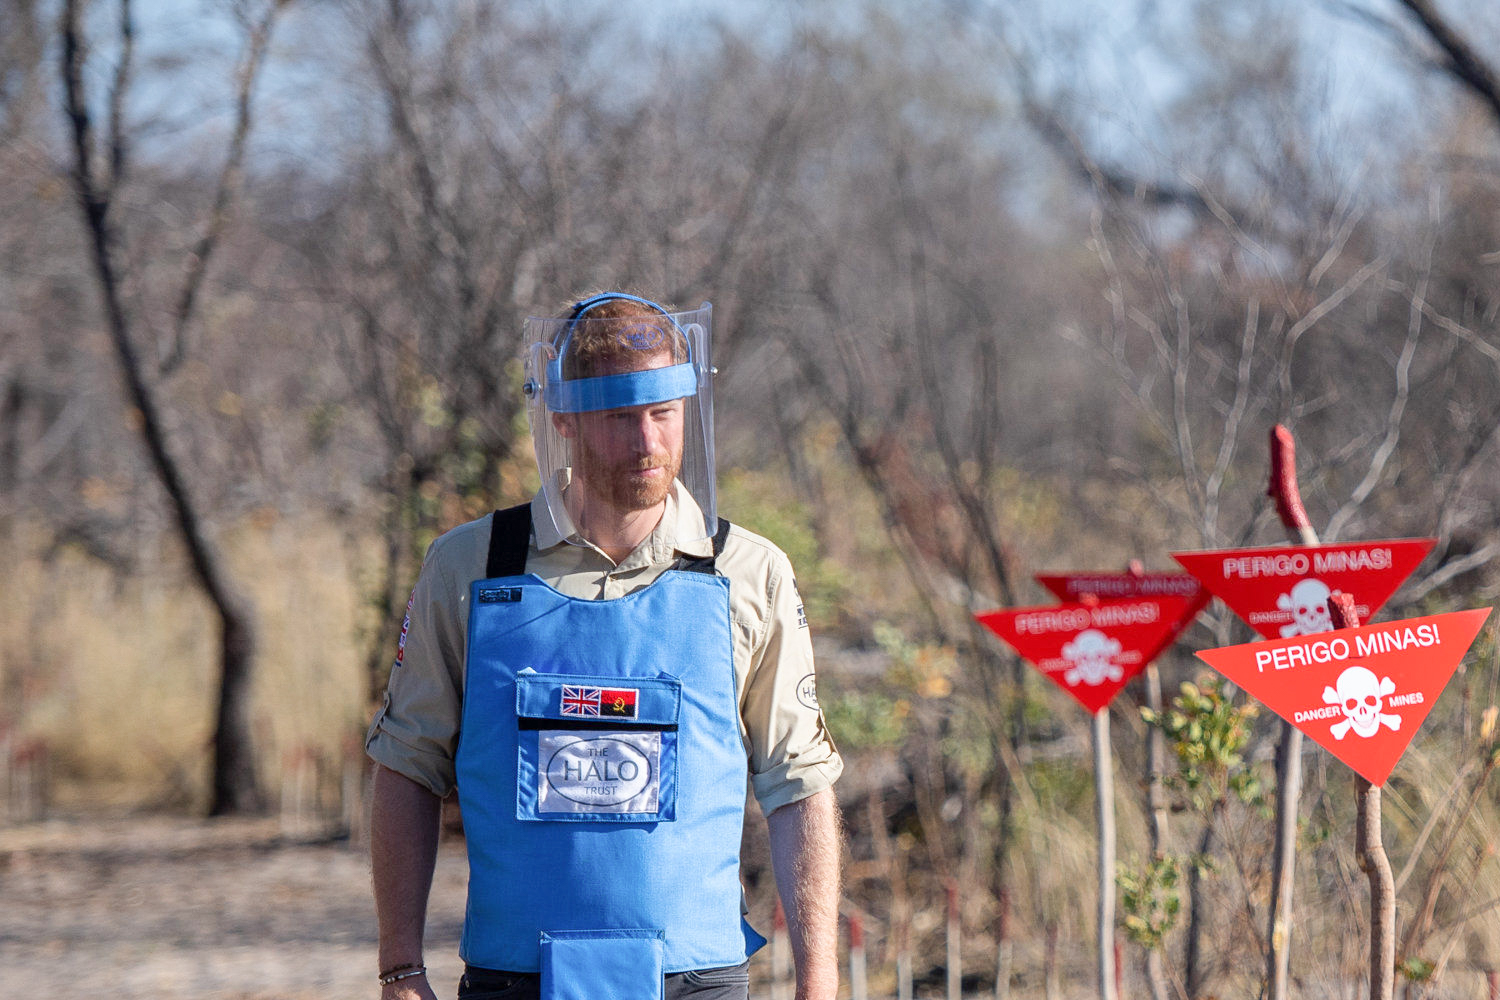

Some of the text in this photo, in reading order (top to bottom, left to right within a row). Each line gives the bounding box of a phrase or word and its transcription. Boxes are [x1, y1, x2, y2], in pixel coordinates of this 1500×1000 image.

[1223, 549, 1393, 579] PERIGO MINAS!
[1255, 624, 1441, 672] PERIGO MINAS!
[1294, 692, 1424, 723] DANGER MINES
[587, 748, 609, 757] THE
[564, 760, 638, 781] HALO
[584, 786, 617, 795] TRUST
